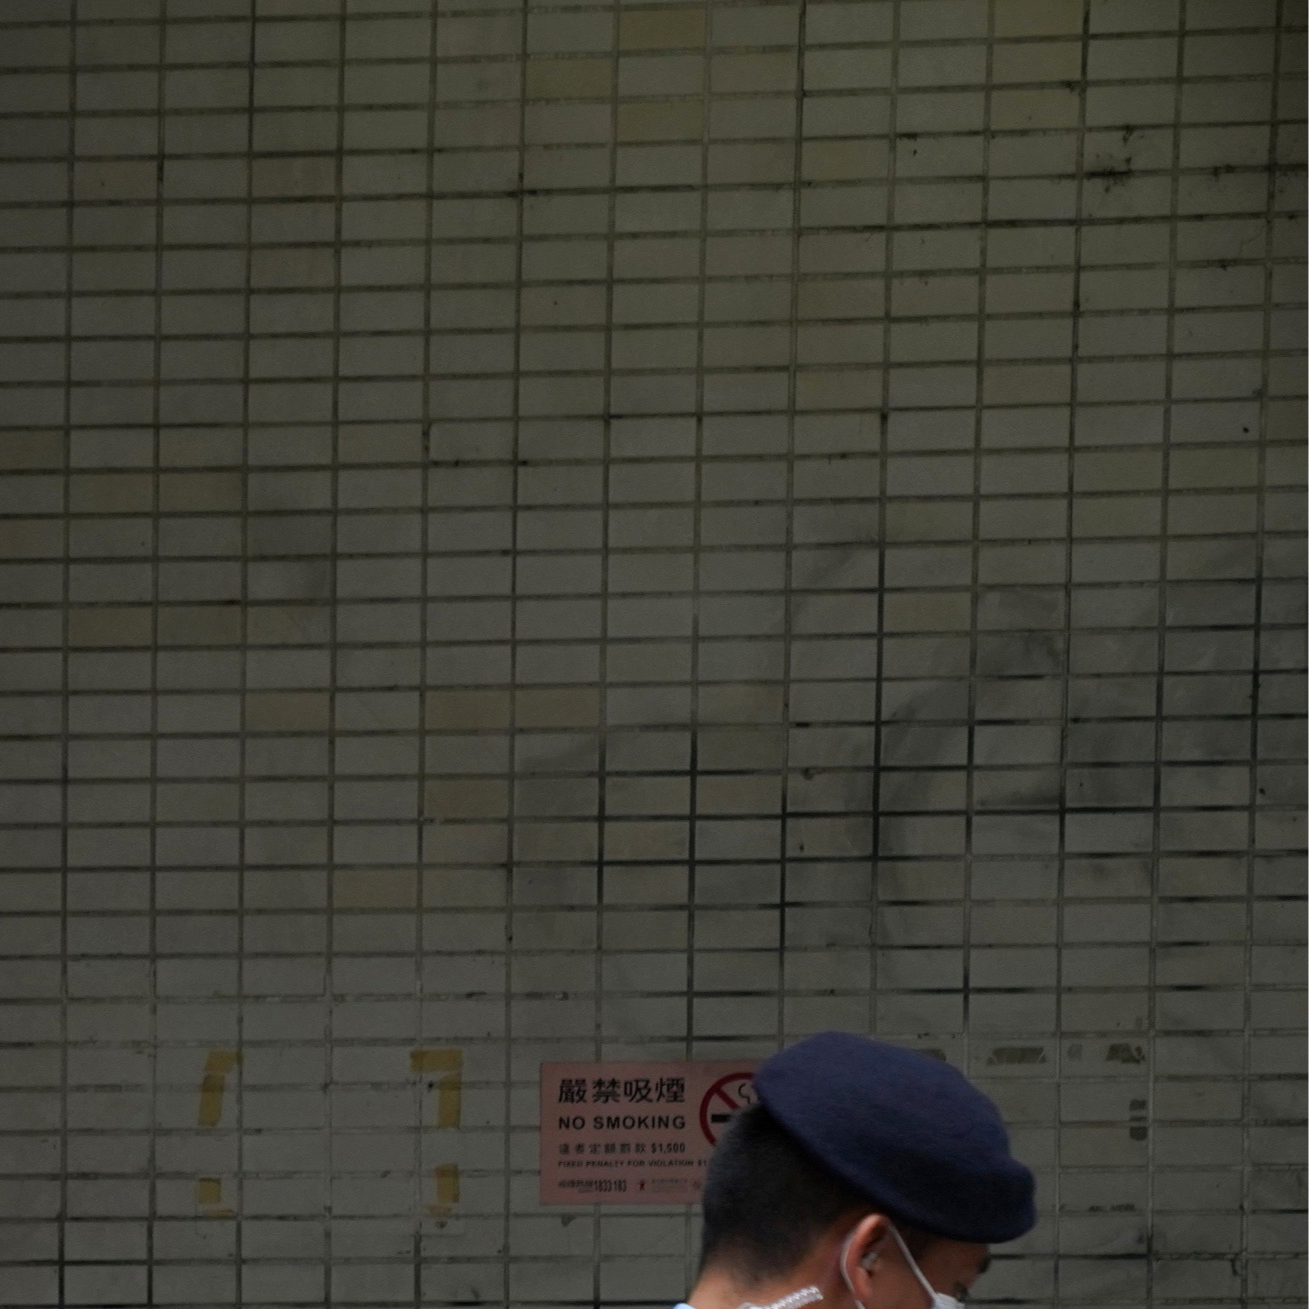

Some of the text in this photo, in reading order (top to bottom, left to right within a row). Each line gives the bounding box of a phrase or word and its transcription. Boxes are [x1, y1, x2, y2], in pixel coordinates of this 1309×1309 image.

[558, 1077, 686, 1103] 嚴禁吸煙
[558, 1115, 686, 1130] NO SMOKING
